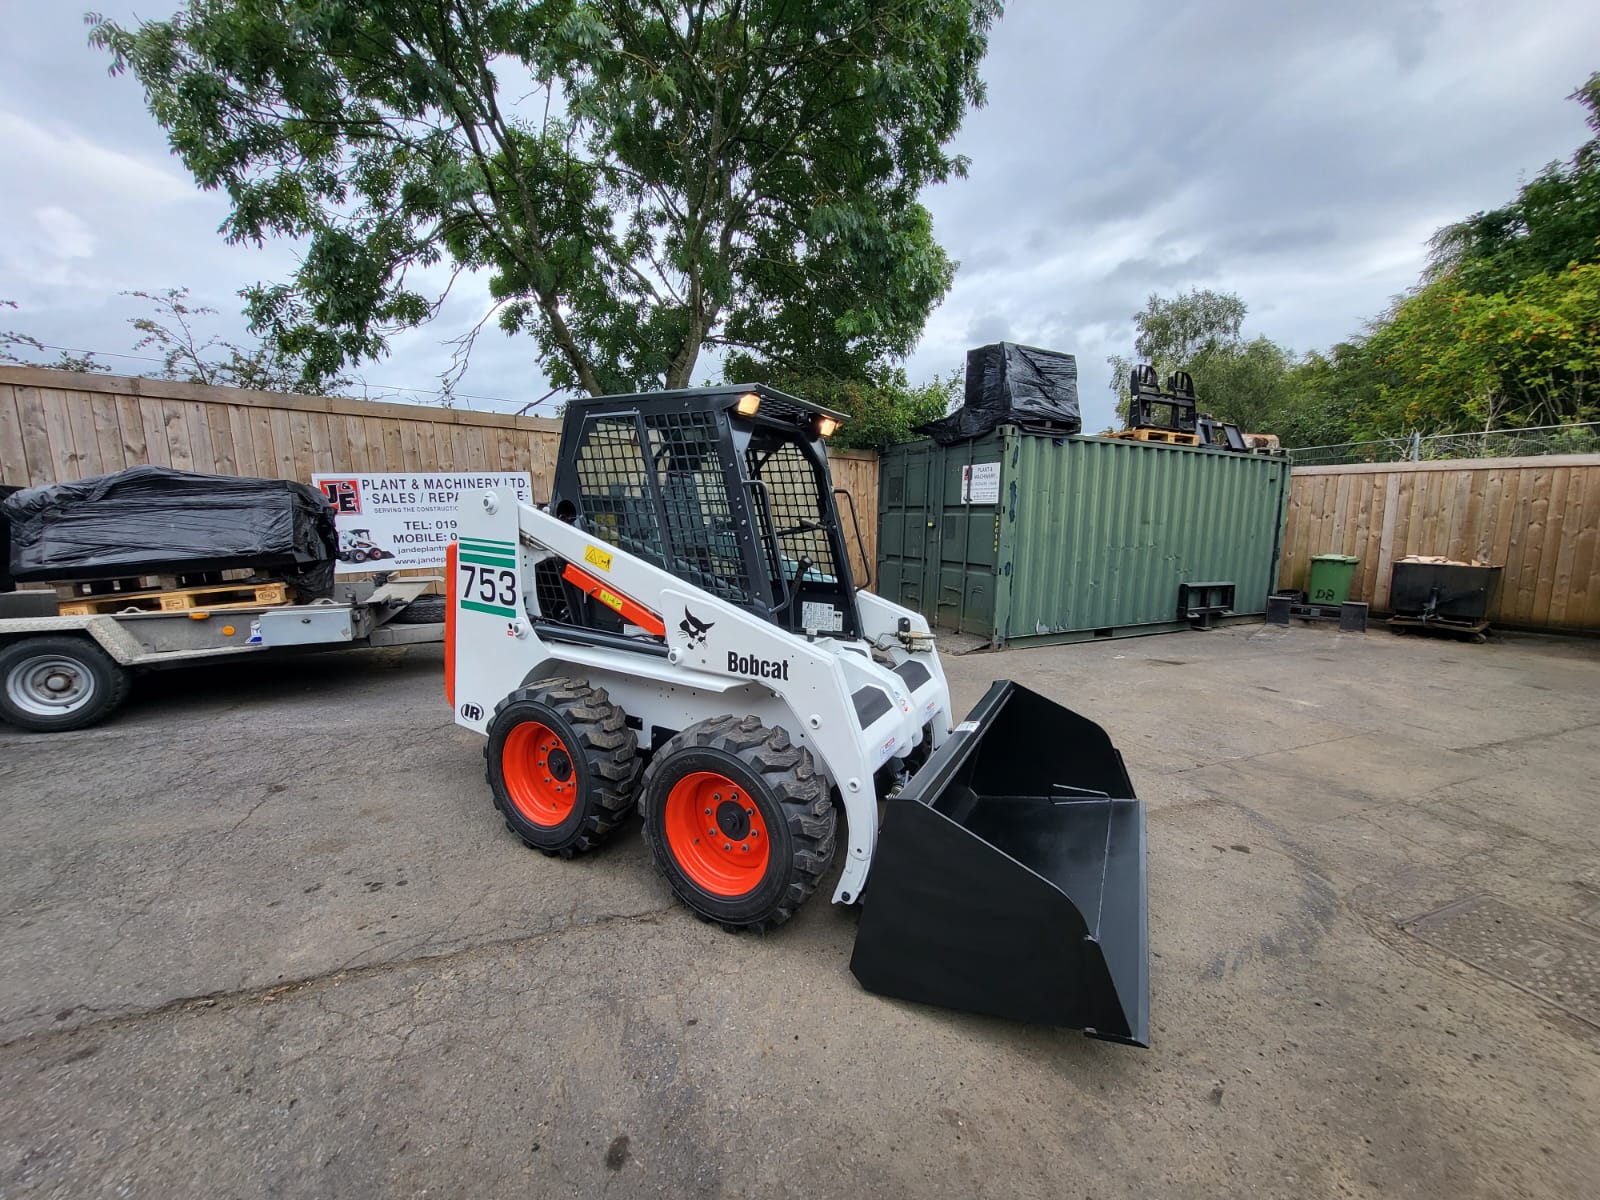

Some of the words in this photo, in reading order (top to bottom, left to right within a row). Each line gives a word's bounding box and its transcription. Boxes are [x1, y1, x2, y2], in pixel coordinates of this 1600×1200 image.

[362, 479, 407, 490] PLANT
[412, 479, 419, 490] &
[423, 478, 500, 489] MACHINERY
[372, 493, 416, 504] SALES
[403, 520, 432, 530] TEL:
[435, 520, 457, 529] 019
[393, 533, 447, 543] MOBILE:
[450, 532, 458, 541] 0
[460, 565, 516, 606] 753
[727, 651, 789, 681] Bobcat
[463, 703, 482, 721] IR
